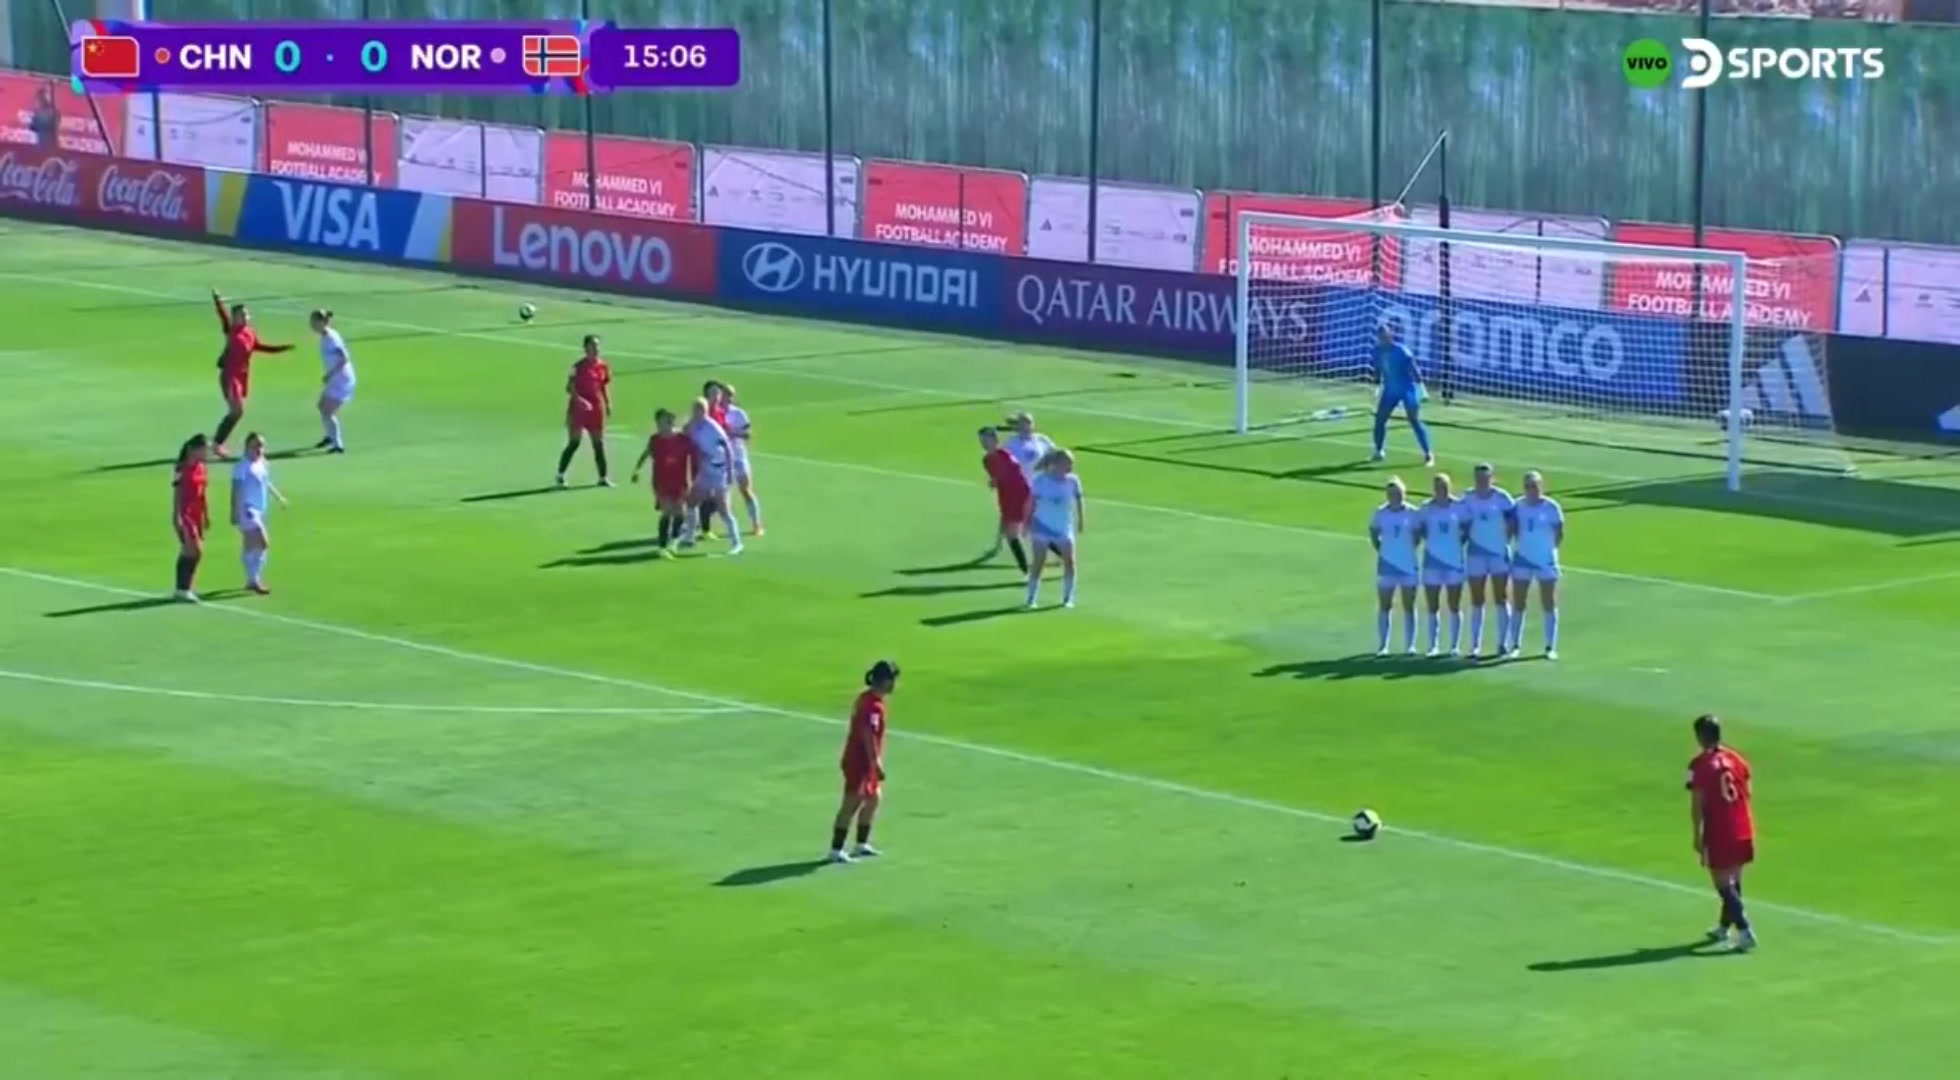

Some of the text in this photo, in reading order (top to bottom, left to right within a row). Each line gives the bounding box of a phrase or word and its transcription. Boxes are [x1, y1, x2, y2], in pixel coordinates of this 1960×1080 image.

[288, 141, 356, 162] MOHAMMED
[328, 166, 381, 187] ACADEY
[649, 179, 664, 196] VI
[272, 180, 380, 250] VISA
[554, 190, 677, 217] FOOTALL ACADEMY
[895, 203, 993, 229] MOHAMMED VI
[492, 203, 672, 284] Lenovo
[876, 224, 1009, 252] FOOTBALL ACADEMY
[1248, 237, 1344, 261] MOHAMMED
[814, 254, 978, 307] HYUNDAI
[1218, 257, 1376, 287] FOTBALL ACADEM
[1655, 271, 1792, 300] MOAMED VI
[1017, 274, 1308, 341] QATAR AIRWAYS
[1721, 303, 1812, 329] AADEMY
[1376, 304, 1624, 380] aramco
[1720, 771, 1739, 802] 6
